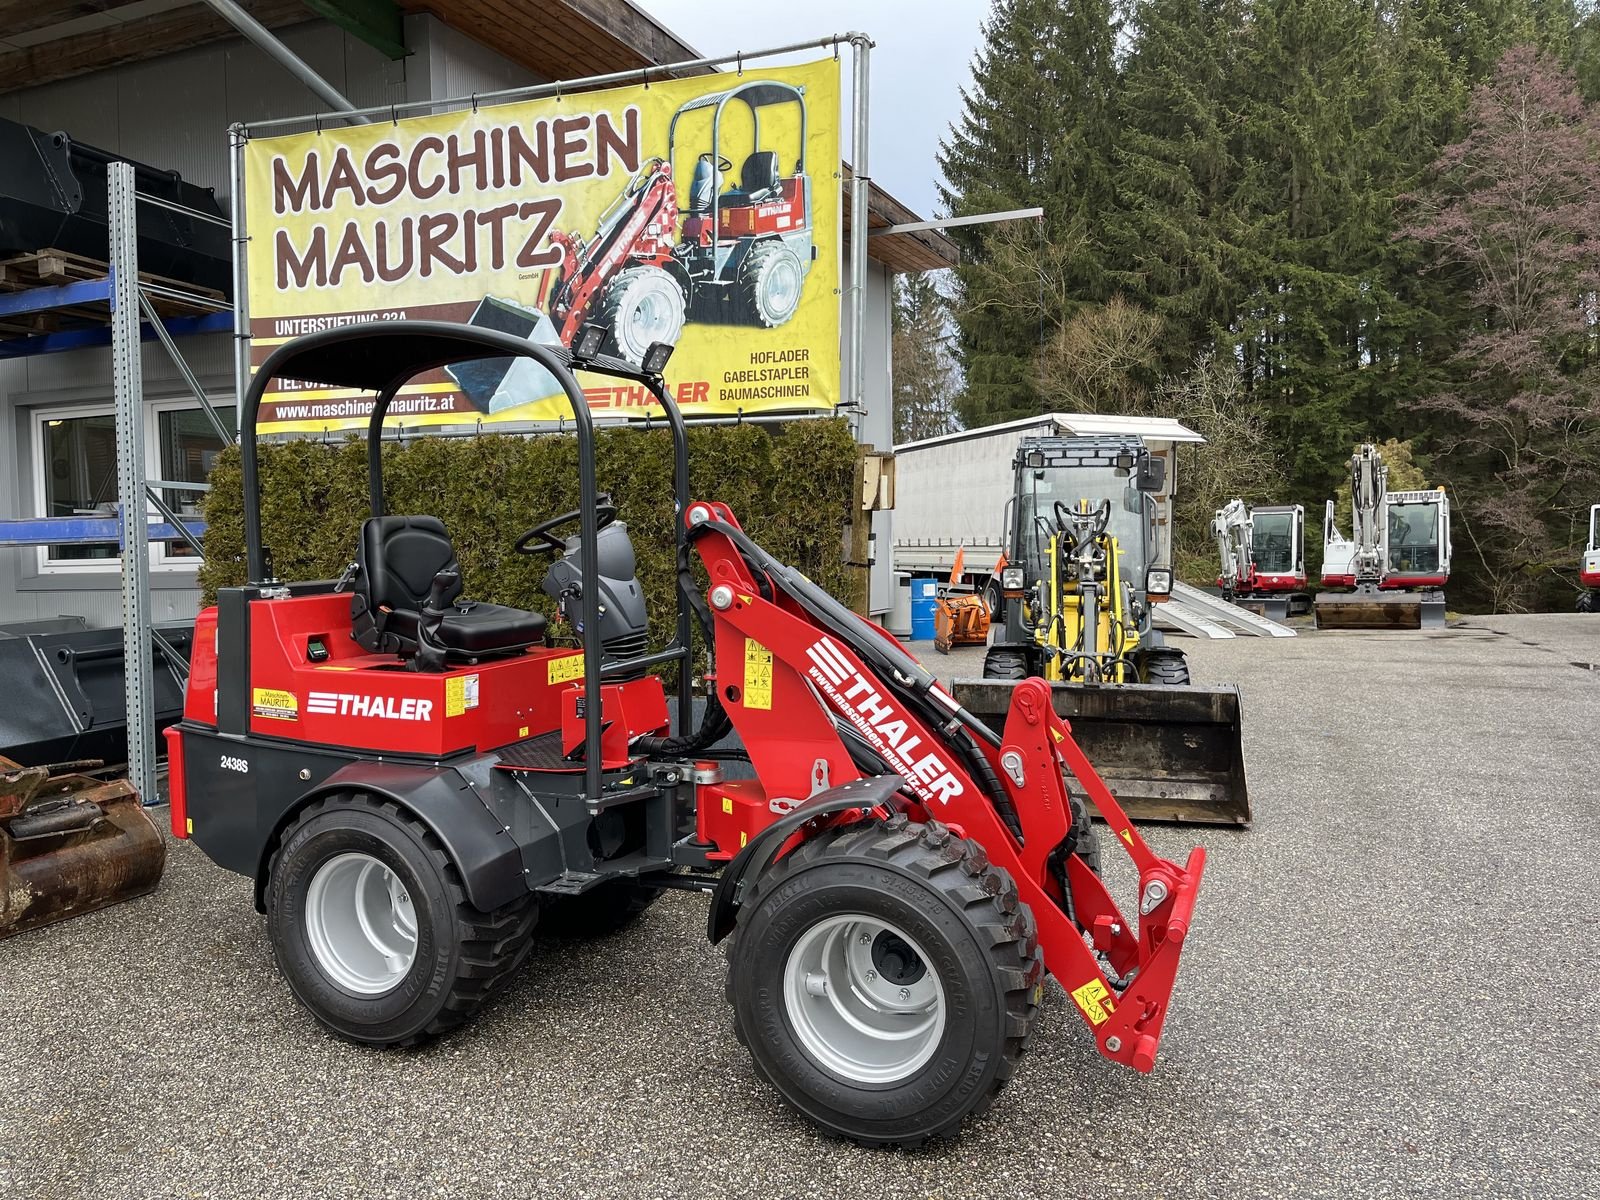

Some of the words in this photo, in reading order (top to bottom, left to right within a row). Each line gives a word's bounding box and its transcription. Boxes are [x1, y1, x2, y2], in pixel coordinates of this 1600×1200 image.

[274, 109, 639, 214] MASCHINEN
[277, 199, 563, 289] MAURITZ
[750, 349, 809, 364] HOFLADER
[723, 367, 809, 383] GABELSTAPLER
[719, 384, 809, 401] BAUMASCHINEN
[260, 697, 290, 708] MAURITZ
[337, 693, 433, 722] THALER
[808, 666, 935, 801] www.maschinen-mauritz.at
[844, 673, 964, 805] THALER
[220, 755, 249, 773] 2438S
